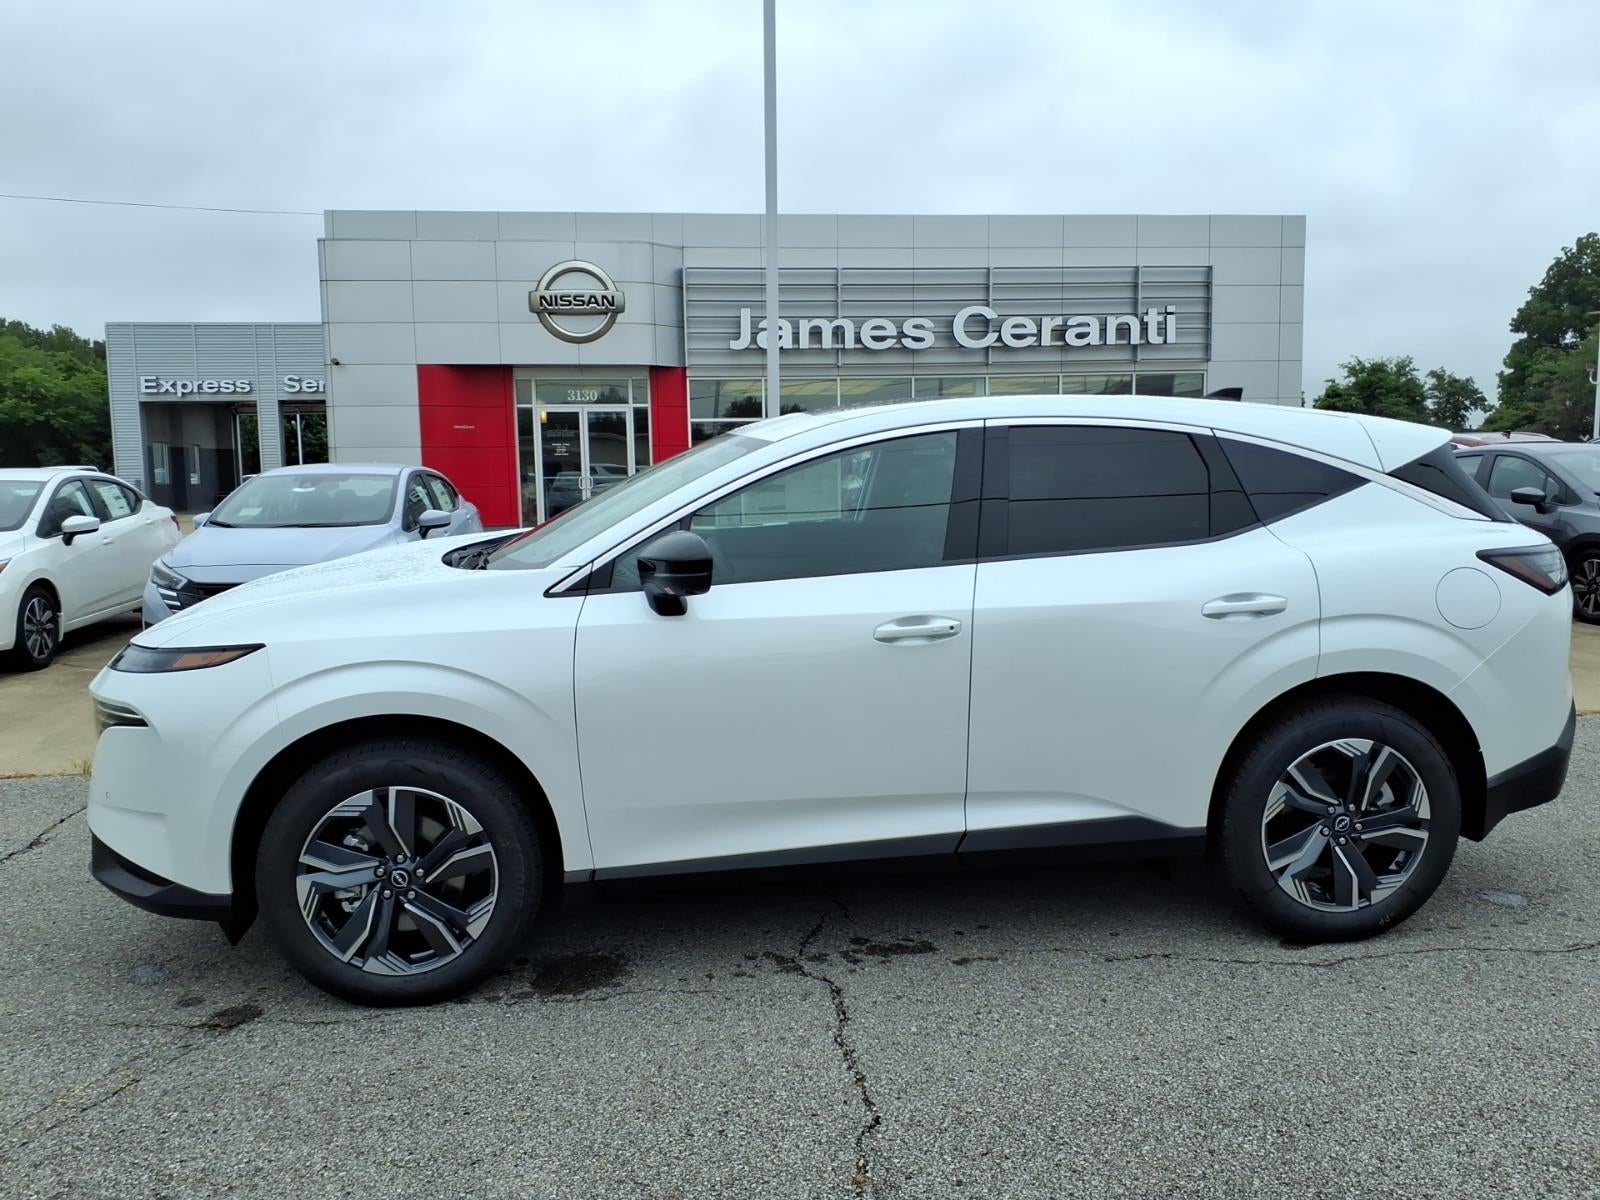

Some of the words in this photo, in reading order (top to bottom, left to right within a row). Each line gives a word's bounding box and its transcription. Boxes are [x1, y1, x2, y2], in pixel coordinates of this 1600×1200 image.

[538, 294, 616, 309] NISSAN
[729, 307, 935, 350] James
[952, 304, 1177, 349] Ceranti
[139, 376, 251, 396] Express
[567, 389, 598, 402] 3130
